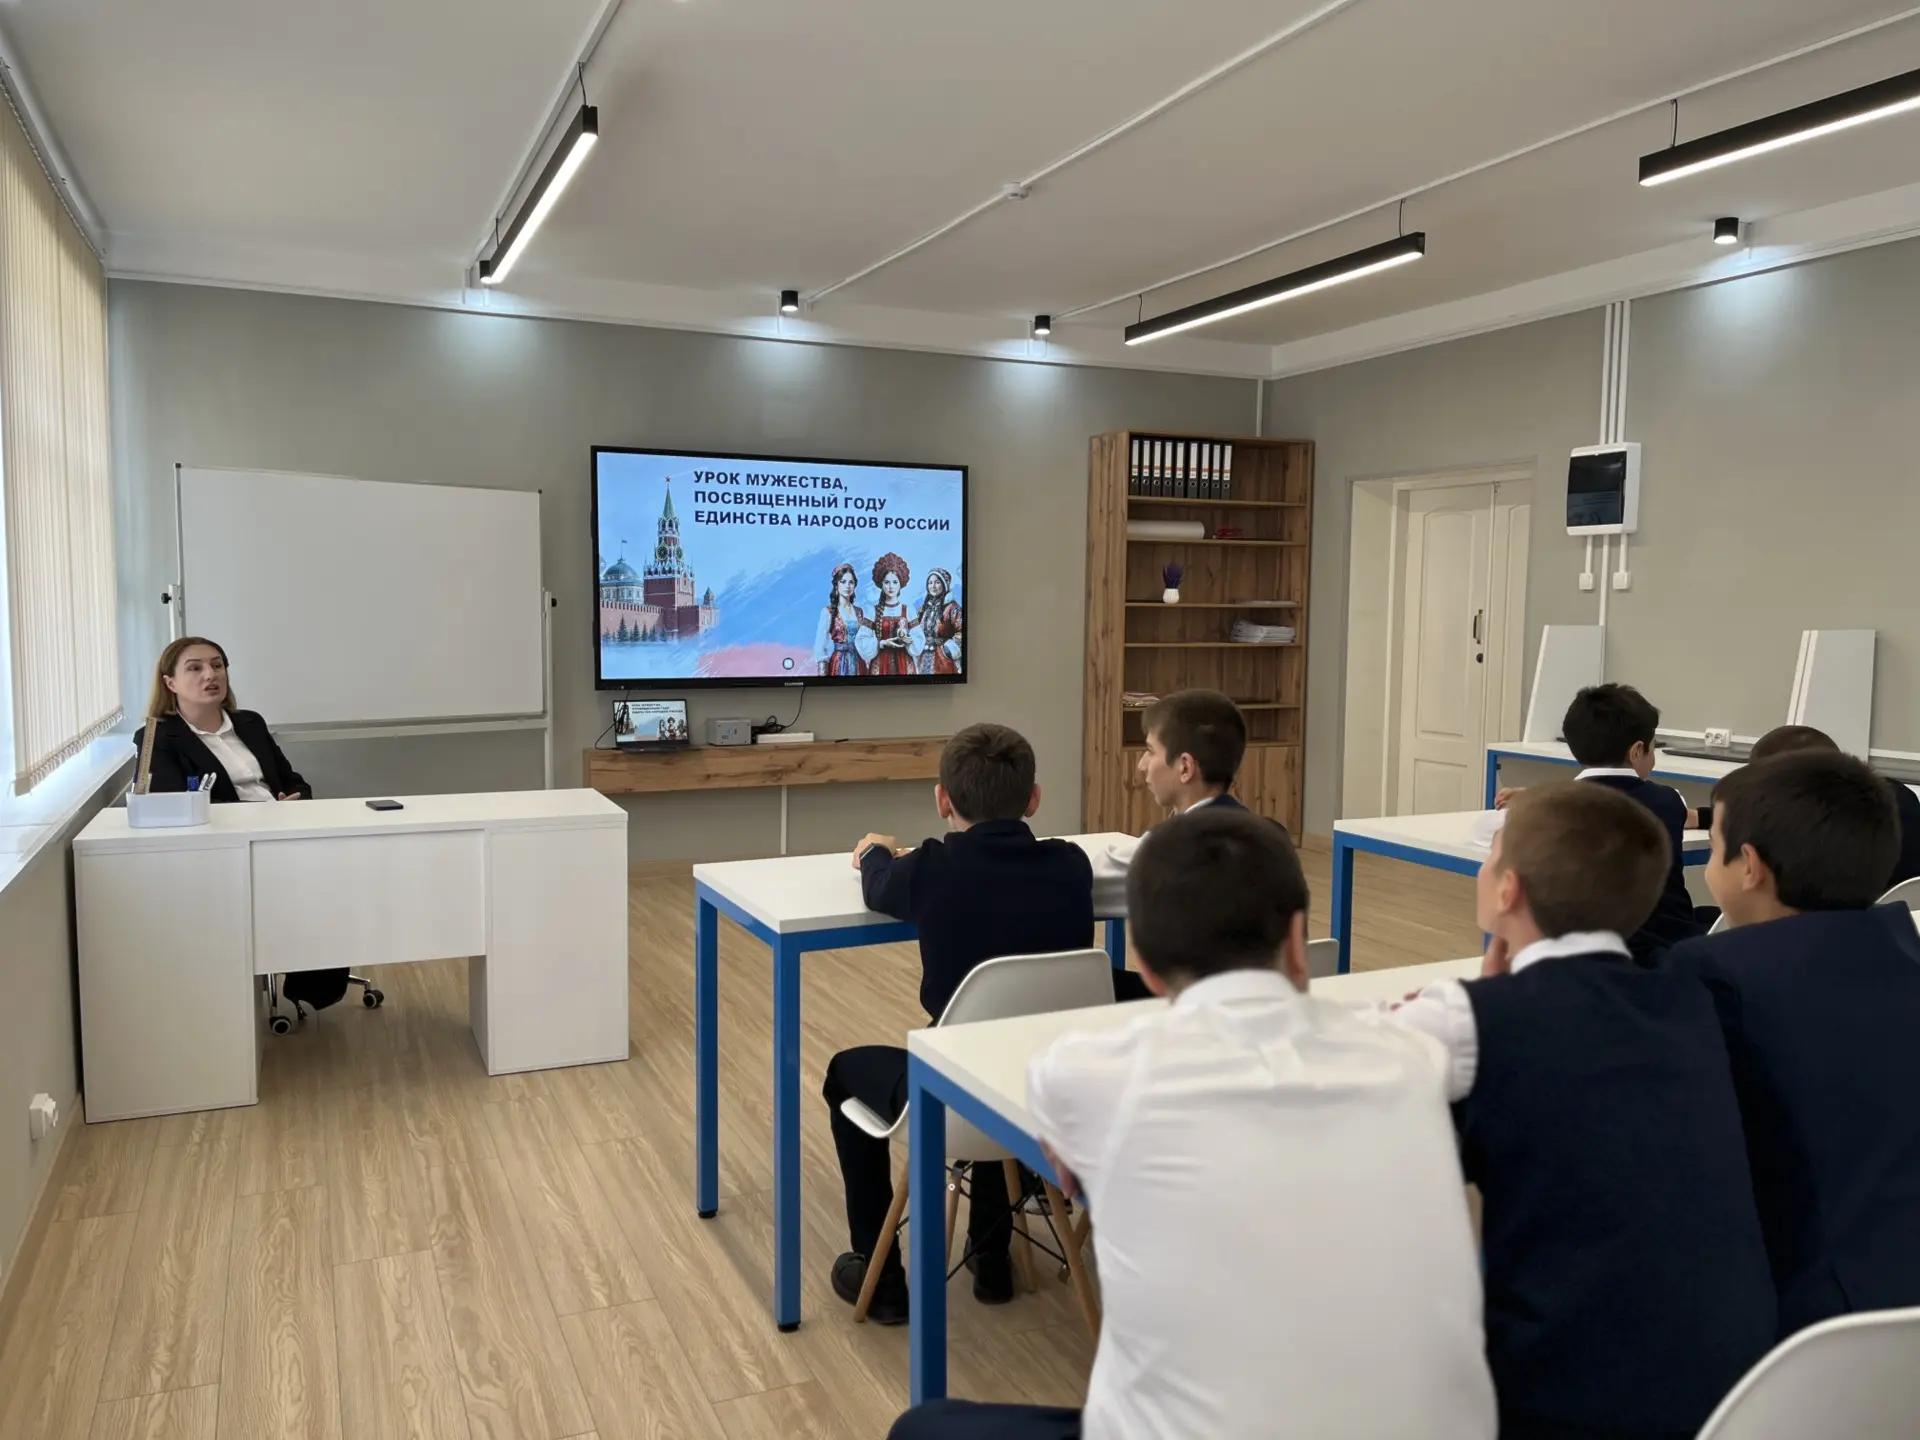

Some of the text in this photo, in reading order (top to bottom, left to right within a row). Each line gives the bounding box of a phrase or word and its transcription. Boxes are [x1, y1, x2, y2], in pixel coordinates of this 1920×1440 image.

[693, 470, 849, 493] УРОК МУЖЕСТВА,
[694, 490, 888, 513] ПОСВЯЩЕННЫЙ ГОДУ
[694, 510, 951, 532] ЕДИНСТВА НАРОДОВ РОССИИ
